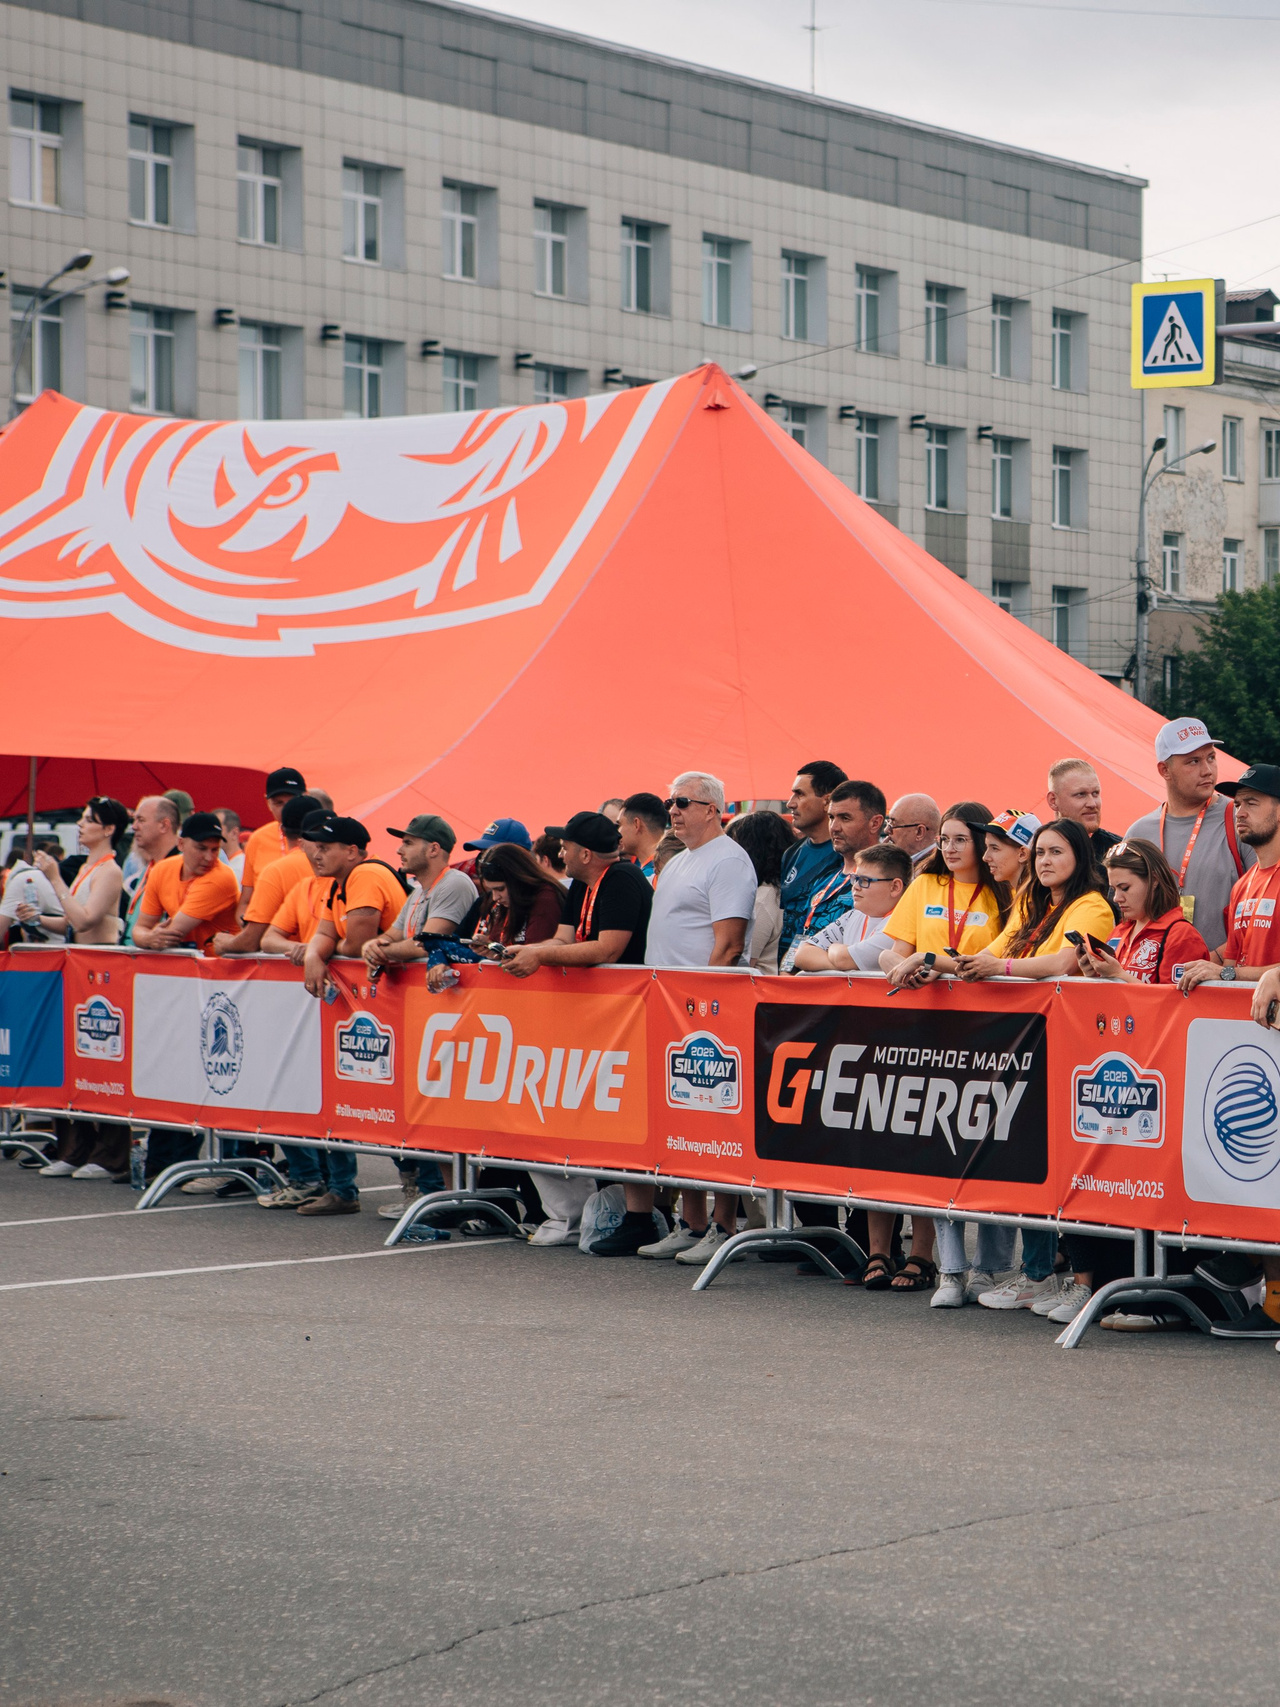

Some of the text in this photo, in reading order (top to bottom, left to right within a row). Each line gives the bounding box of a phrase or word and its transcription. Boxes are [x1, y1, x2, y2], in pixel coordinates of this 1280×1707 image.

[80, 1016, 120, 1033] SILK WAY
[356, 1024, 372, 1035] 2025
[341, 1034, 388, 1053] SILK WAY
[691, 1046, 715, 1058] 2025
[674, 1057, 734, 1078] SILK WAY
[873, 1045, 1033, 1072] МОТОРНОЕ МАСЛО
[692, 1077, 715, 1086] RALLY
[1103, 1070, 1128, 1083] 2025
[1081, 1083, 1153, 1106] SILK WAY
[335, 1103, 396, 1123] #silkwayrally2025
[1101, 1105, 1128, 1115] RALLY
[666, 1135, 743, 1158] #silkwayrally2025
[1070, 1173, 1165, 1200] #silkwayrally2025
